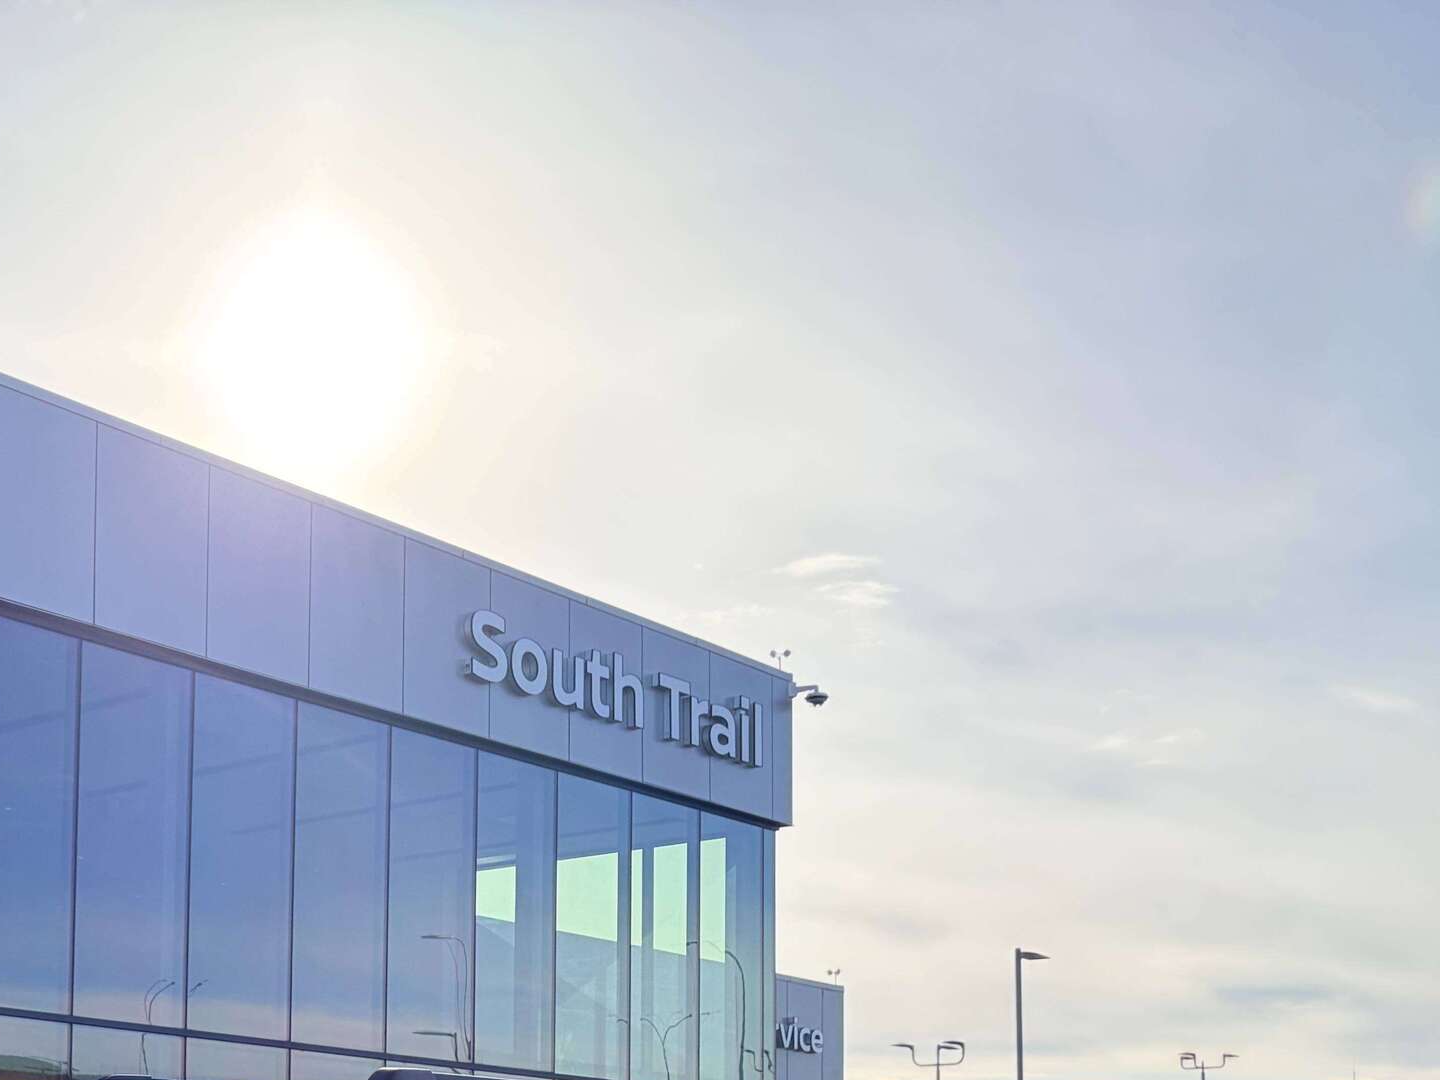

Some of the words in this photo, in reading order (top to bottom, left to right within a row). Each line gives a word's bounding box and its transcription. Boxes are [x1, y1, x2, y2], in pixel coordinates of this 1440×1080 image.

[469, 609, 644, 730] South
[658, 672, 763, 768] Trail
[775, 1016, 824, 1053] vice
